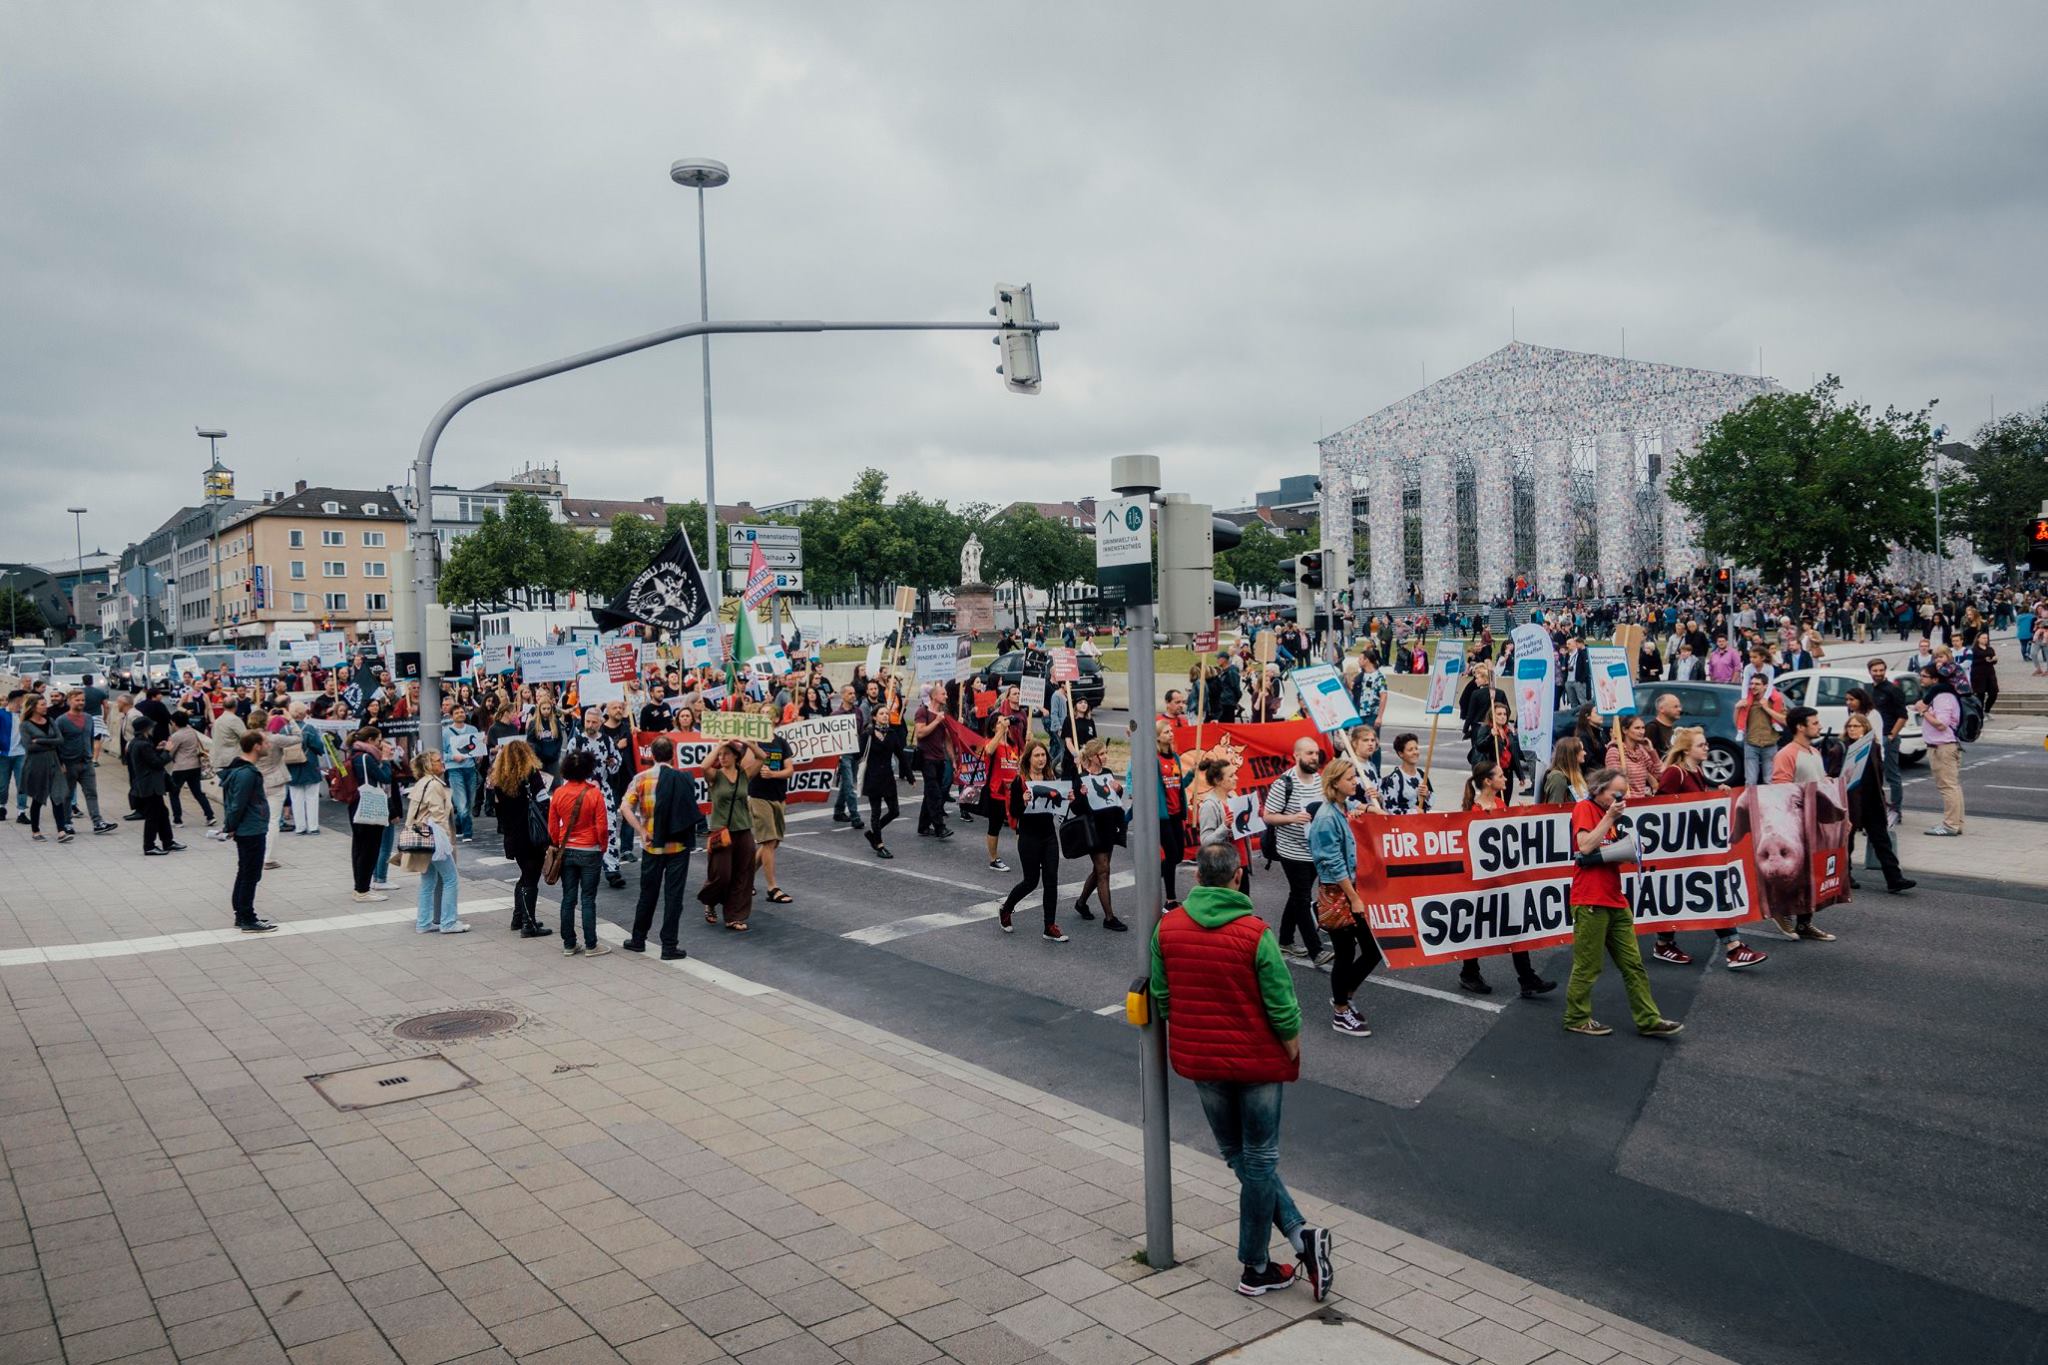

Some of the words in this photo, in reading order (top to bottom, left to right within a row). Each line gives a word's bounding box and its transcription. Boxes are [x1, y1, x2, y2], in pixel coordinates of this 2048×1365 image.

[703, 718, 772, 739] FREIHEIT
[1382, 827, 1420, 858] FÜR
[1423, 829, 1464, 856] DIE
[1368, 903, 1411, 930] ALLER
